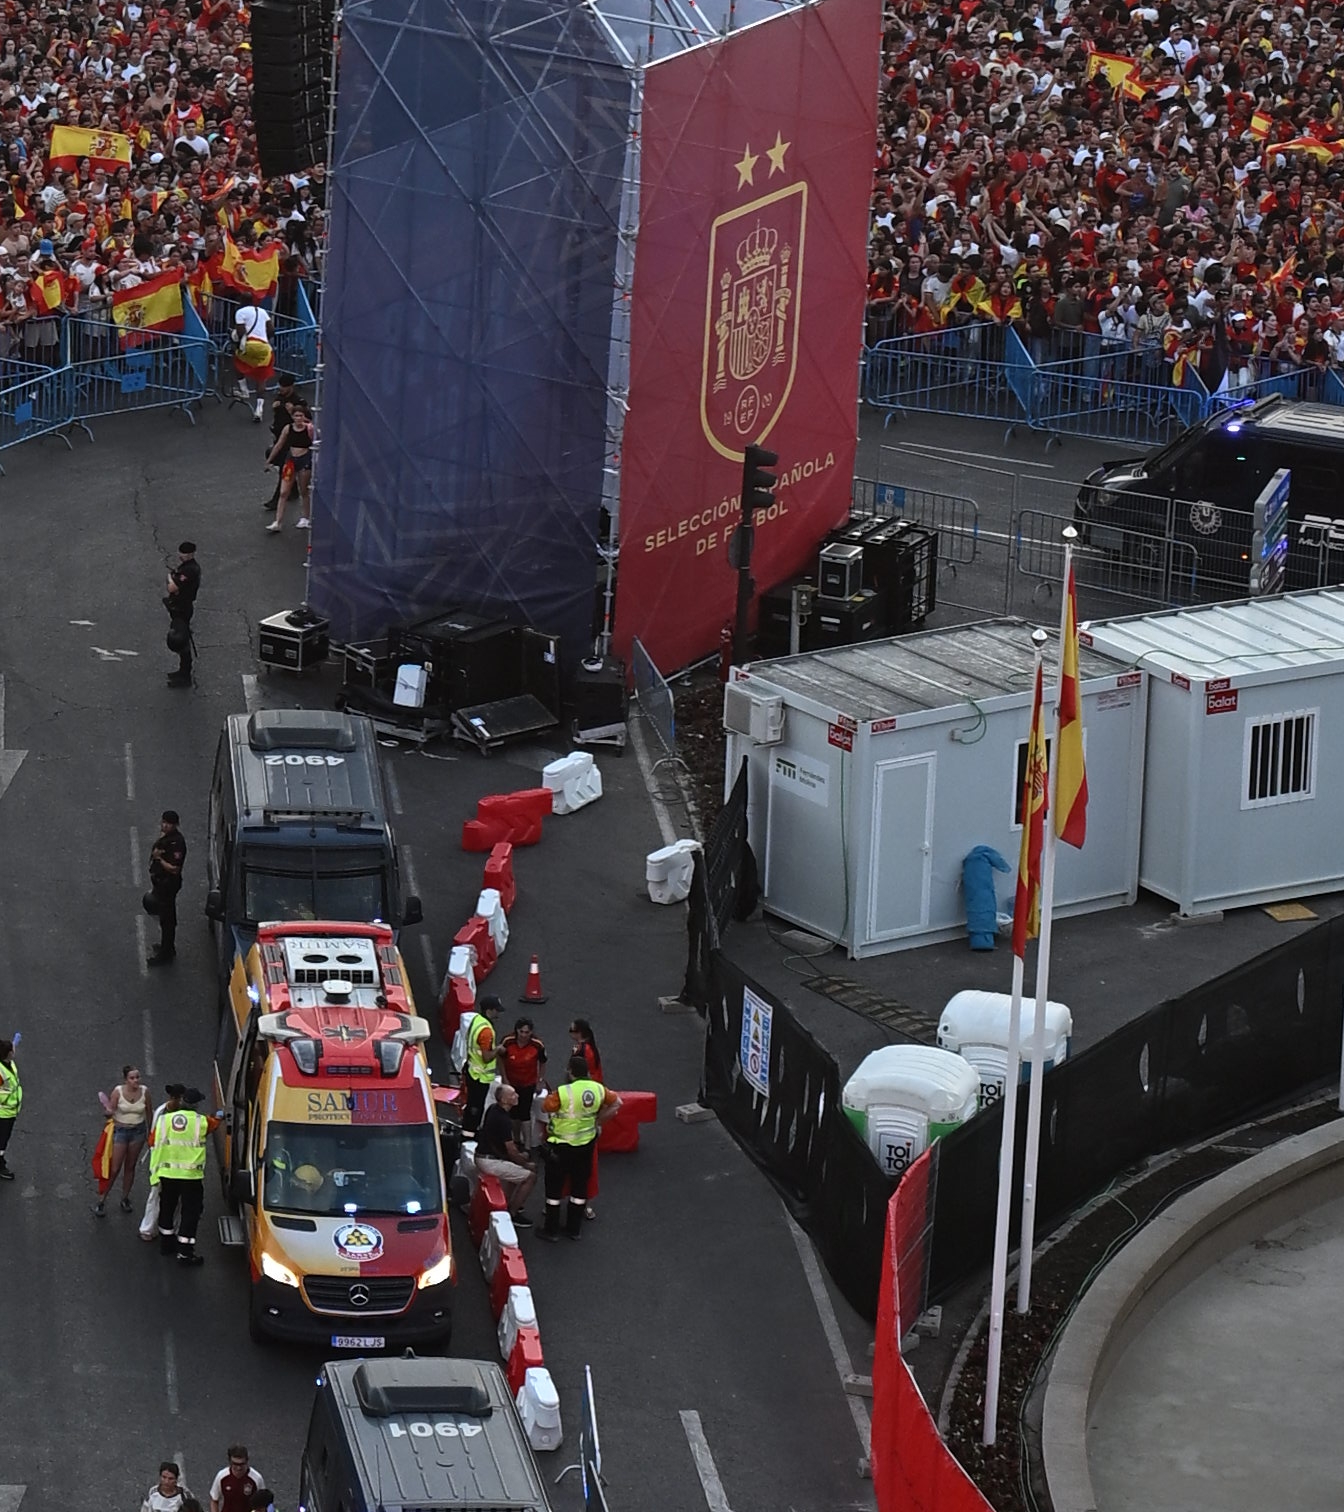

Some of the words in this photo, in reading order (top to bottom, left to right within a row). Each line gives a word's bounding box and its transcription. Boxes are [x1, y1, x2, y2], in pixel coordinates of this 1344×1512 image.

[644, 494, 741, 553] SELECCIÓN
[758, 452, 835, 494] PAÑOLA
[696, 531, 718, 556] DE
[723, 501, 789, 542] FBOL
[1208, 693, 1236, 709] balat
[264, 754, 345, 766] 4902
[289, 941, 370, 950] SAMUR
[307, 1090, 399, 1112] SAMUR
[980, 1095, 996, 1107] TO
[389, 1422, 483, 1438] 4901
